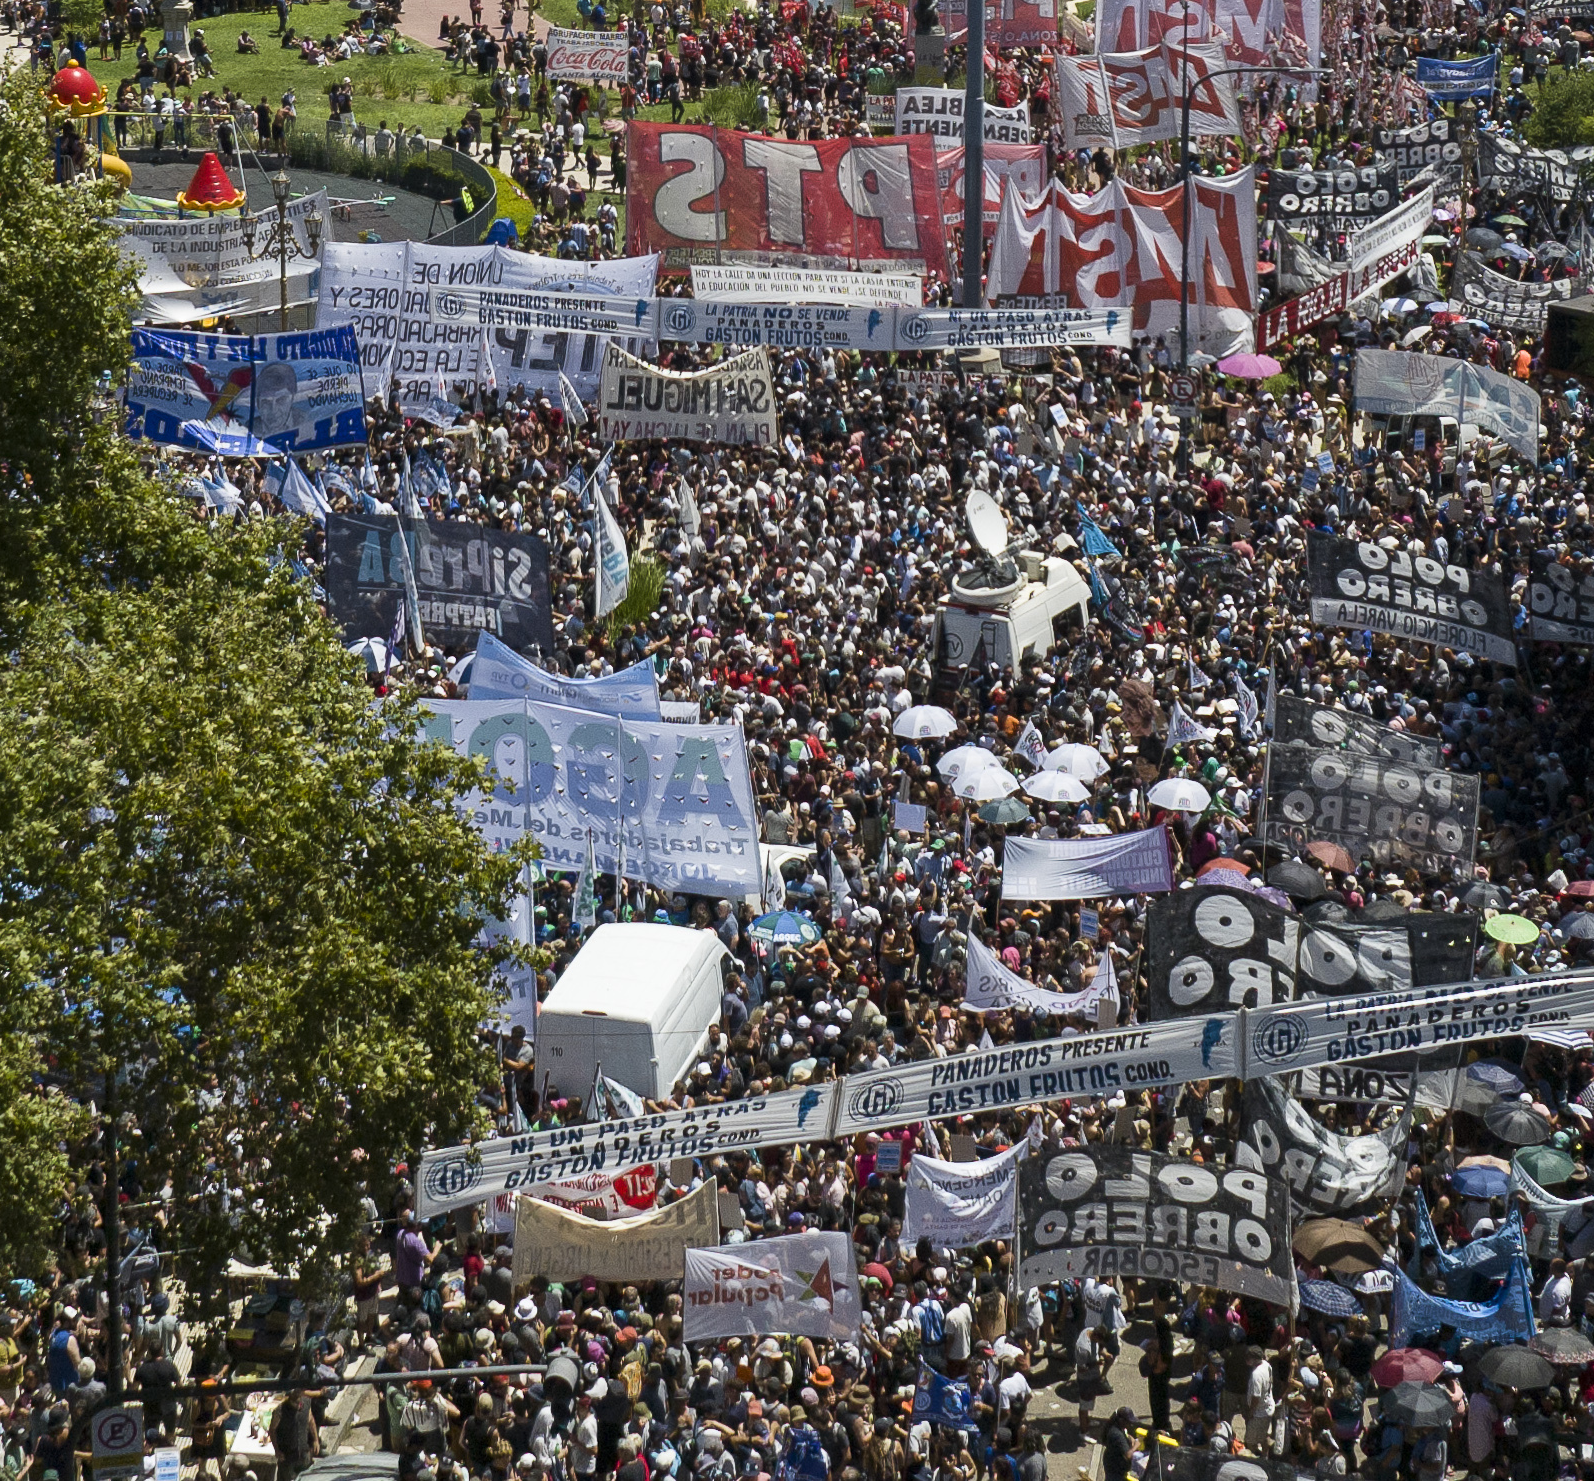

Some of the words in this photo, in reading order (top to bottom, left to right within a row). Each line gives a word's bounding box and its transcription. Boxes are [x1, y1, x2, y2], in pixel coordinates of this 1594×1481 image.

[547, 46, 629, 73] Coca-Cola
[132, 223, 187, 238] INDICATO
[190, 223, 206, 235] DE
[152, 242, 167, 254] DE
[170, 242, 187, 254] LA
[695, 269, 710, 279] HOY
[714, 270, 723, 279] LA
[725, 270, 744, 279] CALLE
[746, 271, 756, 280] DA
[758, 271, 772, 280] UNA
[806, 273, 823, 283] PARA
[826, 275, 839, 284] VER
[850, 276, 860, 285] LA
[862, 277, 884, 286] CASTA
[697, 282, 707, 292] LA
[755, 283, 768, 292] DEL
[771, 283, 799, 293] PUEBLO
[803, 284, 815, 293] NO
[818, 285, 827, 294] SE
[478, 291, 550, 311] PANADEROS
[555, 298, 606, 313] PRESENTE
[705, 303, 719, 317] LA
[763, 306, 793, 320] NO
[798, 307, 813, 320] SE
[815, 309, 851, 321] VENDE
[1266, 305, 1289, 347] LA
[1297, 278, 1344, 331] RIOJA
[478, 308, 532, 329] GASTON
[536, 310, 587, 330] FRUTOS
[717, 317, 825, 331] PANADEROS
[970, 311, 990, 323] UN
[997, 311, 1036, 323] PASO
[1044, 310, 1093, 322] ATRAS
[705, 327, 765, 344] GASTON
[767, 329, 824, 347] FRUTOS
[824, 331, 851, 343] COND.
[947, 331, 1005, 347] GASTON
[1011, 331, 1067, 346] FRUTOS
[1346, 999, 1531, 1037] PANADEROS
[1327, 1029, 1421, 1062] GASTON
[1432, 1015, 1527, 1048] FRUTOS
[551, 1047, 564, 1058] 110
[930, 1044, 1052, 1087] PANADEROS
[1061, 1030, 1152, 1061] PRESENTE
[927, 1076, 1019, 1116] GASTON
[1030, 1061, 1121, 1097] FRUTOS
[1124, 1059, 1175, 1084] COND.
[550, 1126, 584, 1147] UN
[603, 1116, 667, 1139] PASO
[504, 1151, 605, 1190] GASTON
[617, 1136, 714, 1167] FRUTOS
